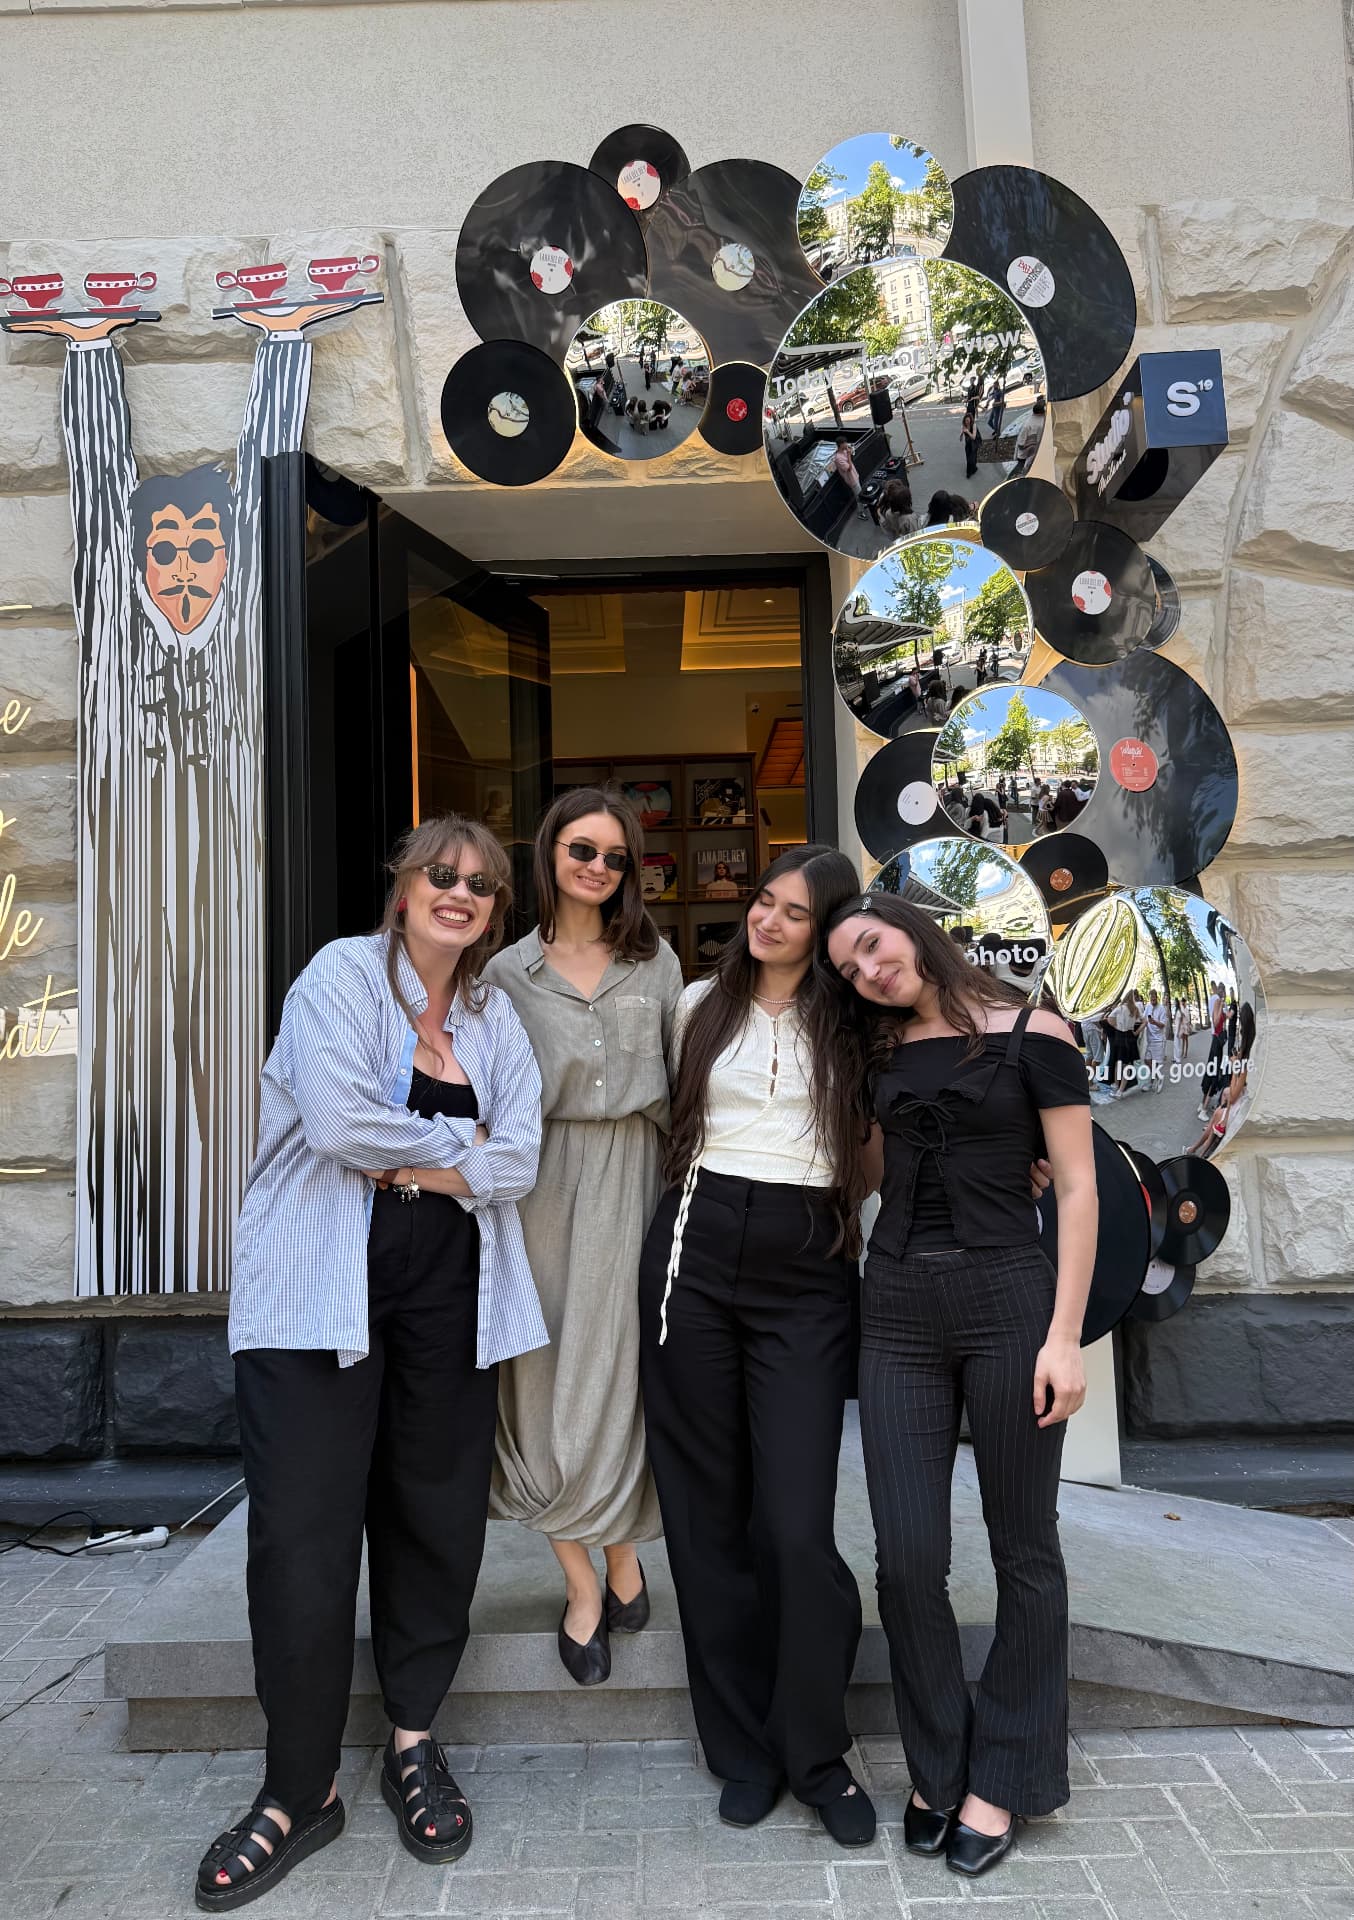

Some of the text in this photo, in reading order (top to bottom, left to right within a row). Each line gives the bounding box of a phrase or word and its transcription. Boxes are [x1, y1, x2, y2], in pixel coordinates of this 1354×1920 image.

[772, 361, 853, 397] Today's
[962, 328, 1021, 353] view
[1085, 1065, 1109, 1081] ou
[1116, 1059, 1165, 1081] look
[1169, 1056, 1217, 1084] good
